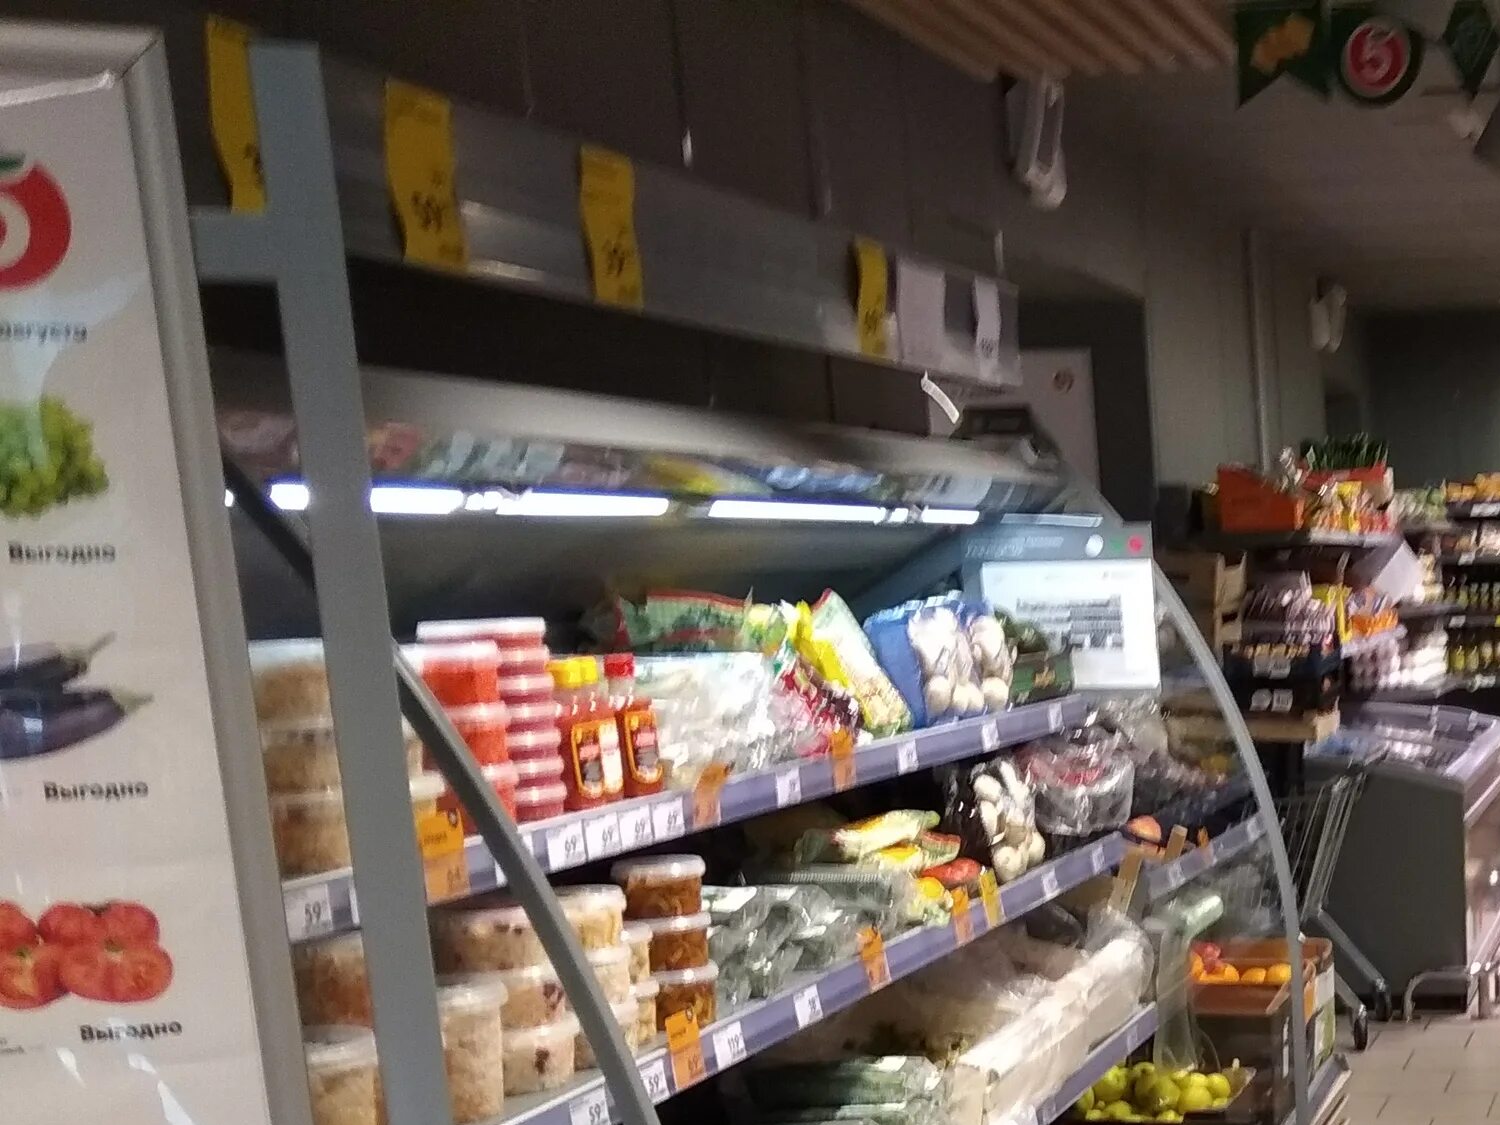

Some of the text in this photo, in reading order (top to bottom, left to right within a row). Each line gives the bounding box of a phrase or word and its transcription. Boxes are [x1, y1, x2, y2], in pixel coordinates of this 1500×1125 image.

[43, 778, 149, 802] Выгодно
[304, 902, 322, 926] 59
[79, 1018, 183, 1043] Выгодно
[648, 1074, 660, 1092] 59
